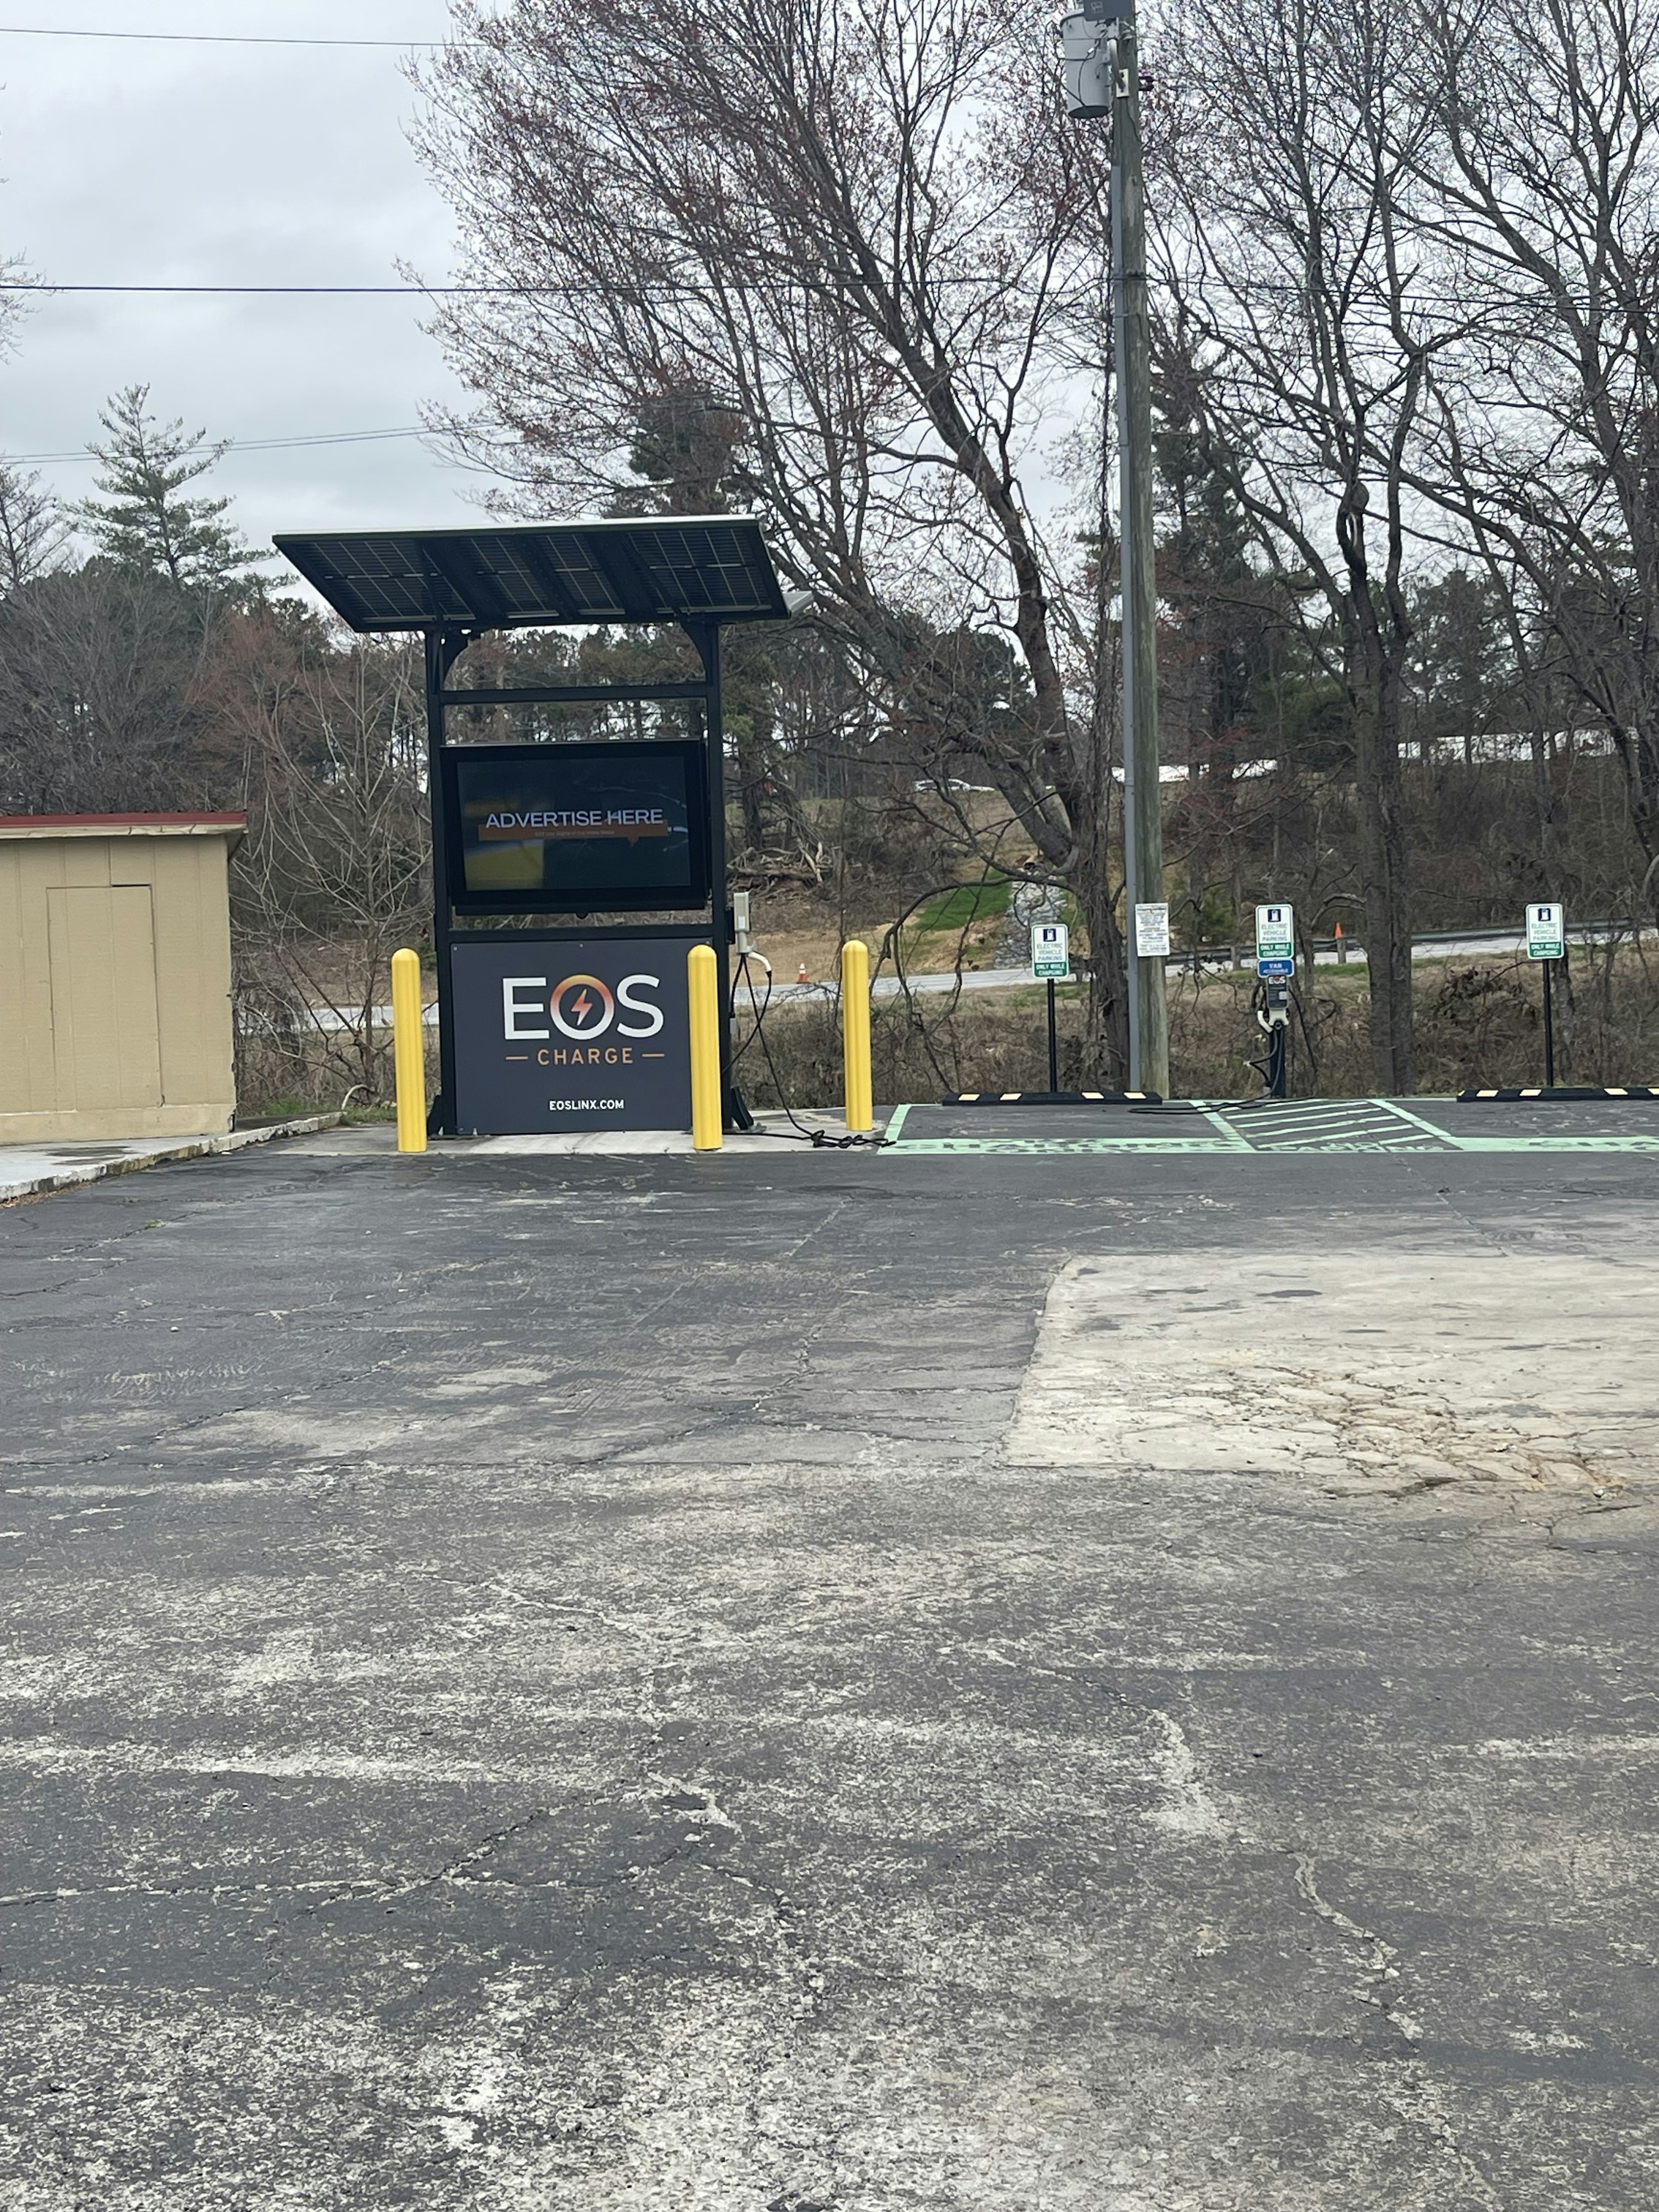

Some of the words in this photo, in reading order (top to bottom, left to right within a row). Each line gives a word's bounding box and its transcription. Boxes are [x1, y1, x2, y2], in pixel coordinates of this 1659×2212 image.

[486, 810, 602, 828] ADVERTISE
[607, 809, 664, 825] HERE
[503, 974, 664, 1040] EOS
[538, 1047, 633, 1065] CHARGE
[549, 1099, 625, 1110] EOSLINX.COM
